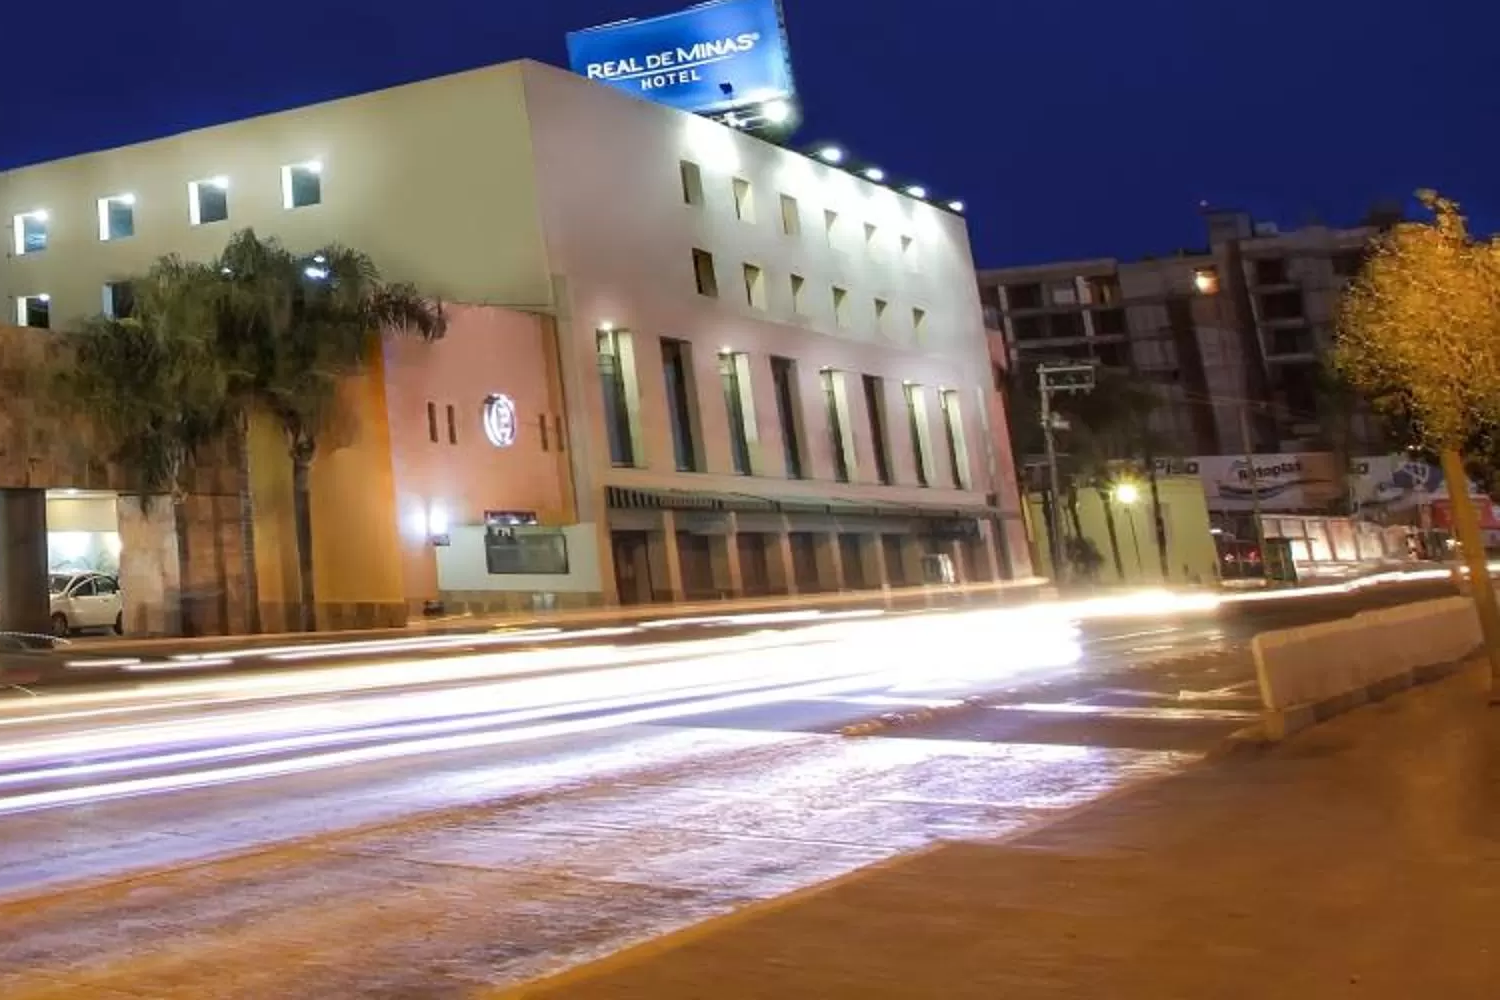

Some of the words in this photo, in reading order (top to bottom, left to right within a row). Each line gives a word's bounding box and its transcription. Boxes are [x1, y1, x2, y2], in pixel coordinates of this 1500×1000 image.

[587, 57, 644, 79] REAL
[646, 51, 674, 70] DE
[677, 33, 755, 63] MINAS
[641, 69, 701, 90] HOTEL
